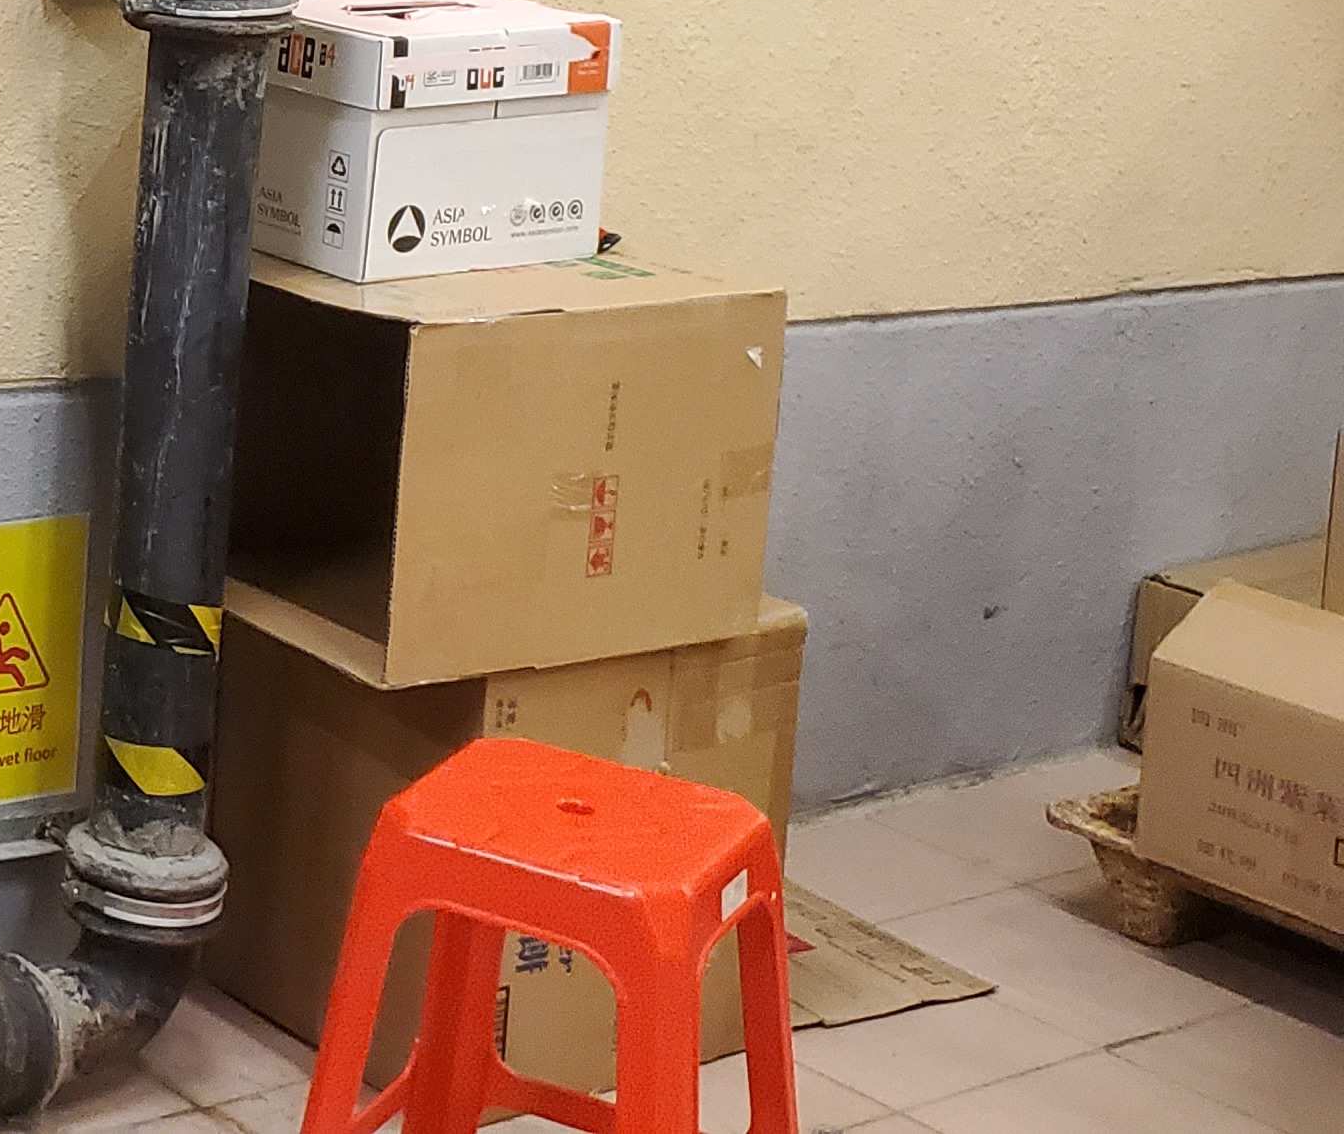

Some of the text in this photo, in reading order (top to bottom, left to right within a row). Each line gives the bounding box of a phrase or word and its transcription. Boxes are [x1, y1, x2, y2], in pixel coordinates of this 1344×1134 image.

[261, 186, 283, 204] ASIA
[257, 203, 301, 227] SYMBOL
[430, 226, 492, 247] SYMBOL
[24, 745, 58, 763] floor
